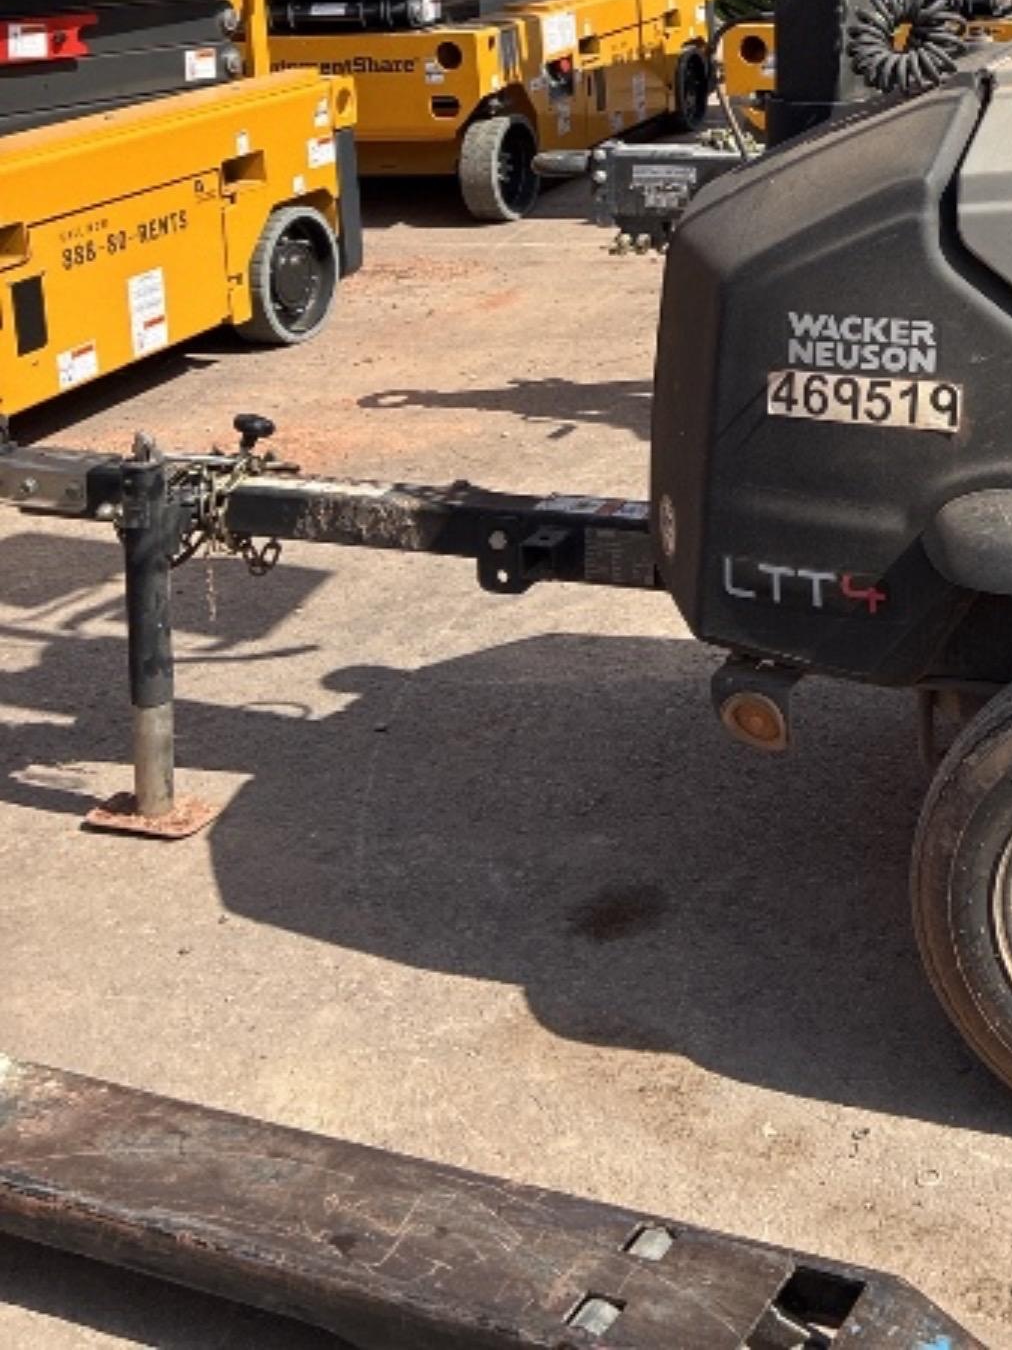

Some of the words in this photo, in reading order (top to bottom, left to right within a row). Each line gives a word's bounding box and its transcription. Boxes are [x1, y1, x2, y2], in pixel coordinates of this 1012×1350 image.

[787, 311, 938, 347] WACKER
[787, 337, 938, 374] NEUSON
[769, 370, 960, 427] 469519
[724, 555, 888, 615] LTT4
